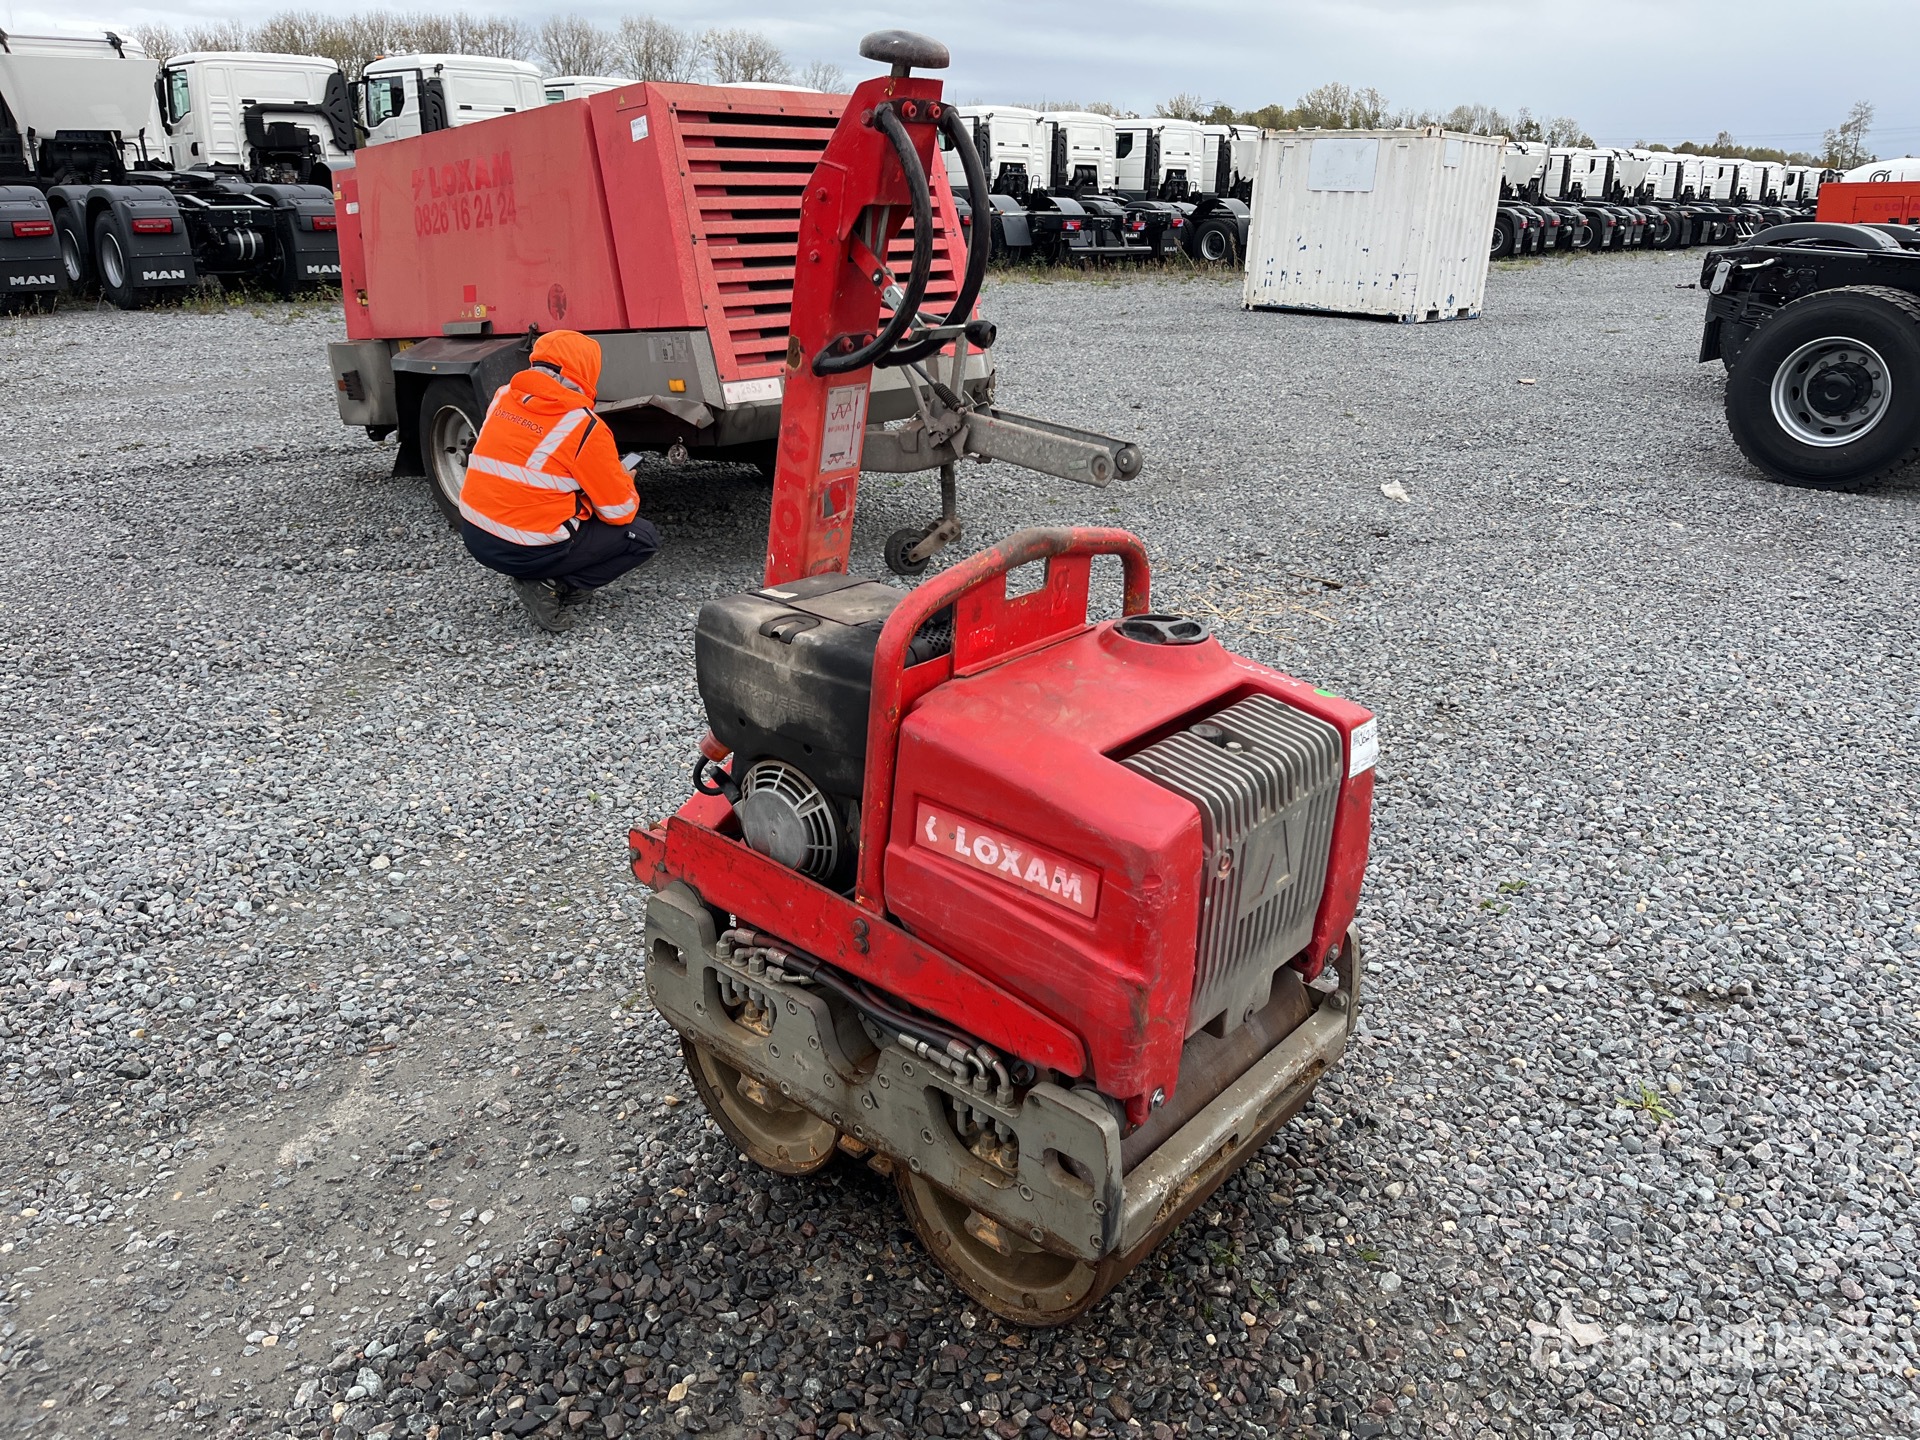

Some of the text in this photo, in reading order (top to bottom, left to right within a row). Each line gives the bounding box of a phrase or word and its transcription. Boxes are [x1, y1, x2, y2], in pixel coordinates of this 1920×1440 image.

[428, 150, 514, 198] LOXAM
[414, 188, 517, 237] 0826 16 24 24
[142, 269, 186, 281] MAN
[306, 264, 342, 274] MAN
[9, 274, 56, 286] MAN
[500, 410, 523, 425] RITCHIE
[954, 825, 1084, 905] LOXAM
